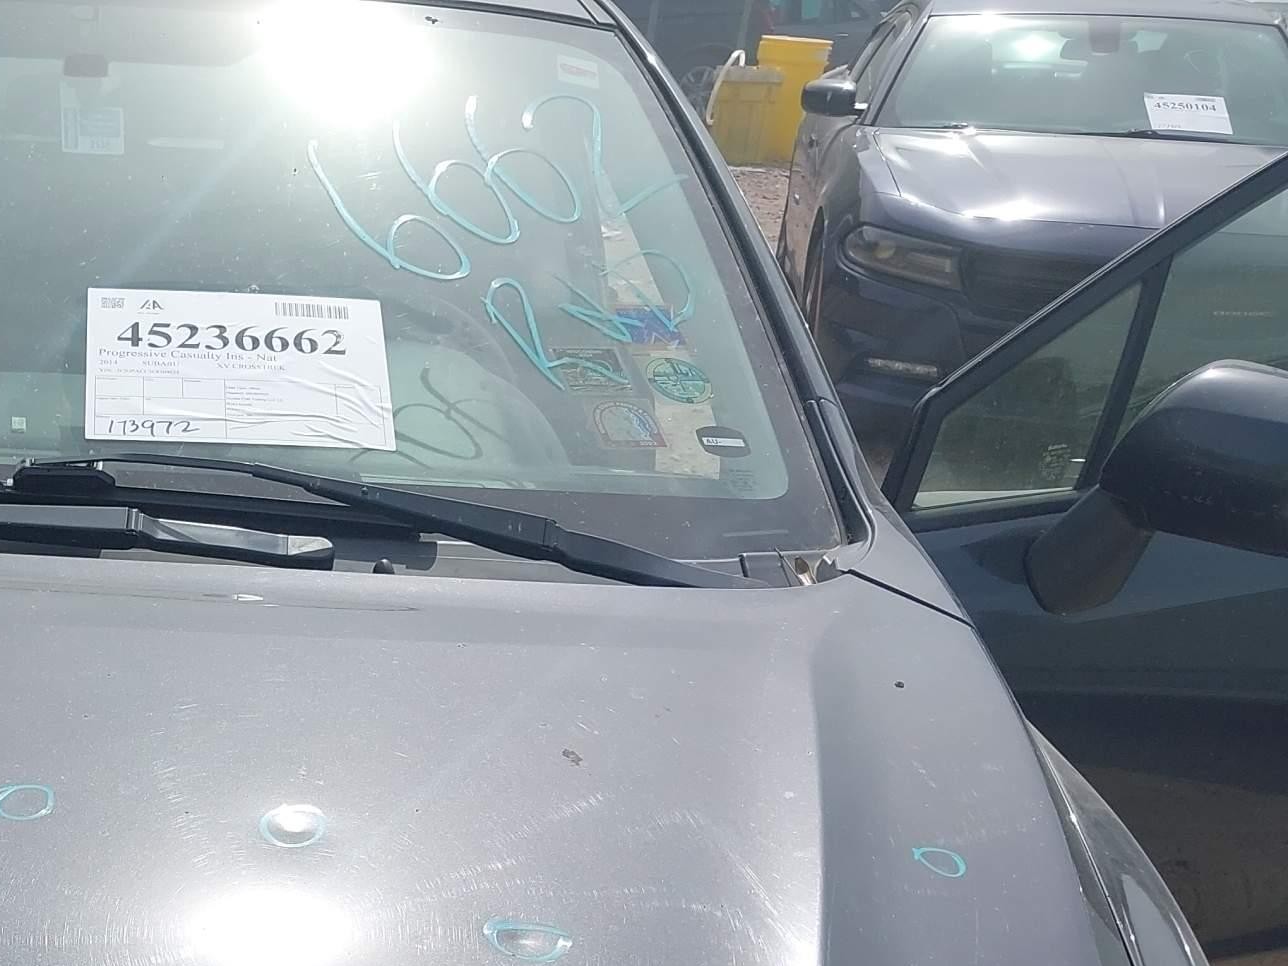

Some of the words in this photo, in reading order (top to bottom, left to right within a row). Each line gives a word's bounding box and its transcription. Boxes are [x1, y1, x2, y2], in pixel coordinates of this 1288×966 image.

[1154, 101, 1217, 112] 45250104
[116, 321, 348, 357] 45236662
[98, 347, 167, 359] Progressive
[170, 350, 222, 362] Casualty
[226, 352, 244, 361] Ins
[256, 352, 278, 362] Nat
[107, 419, 201, 438] 173972
